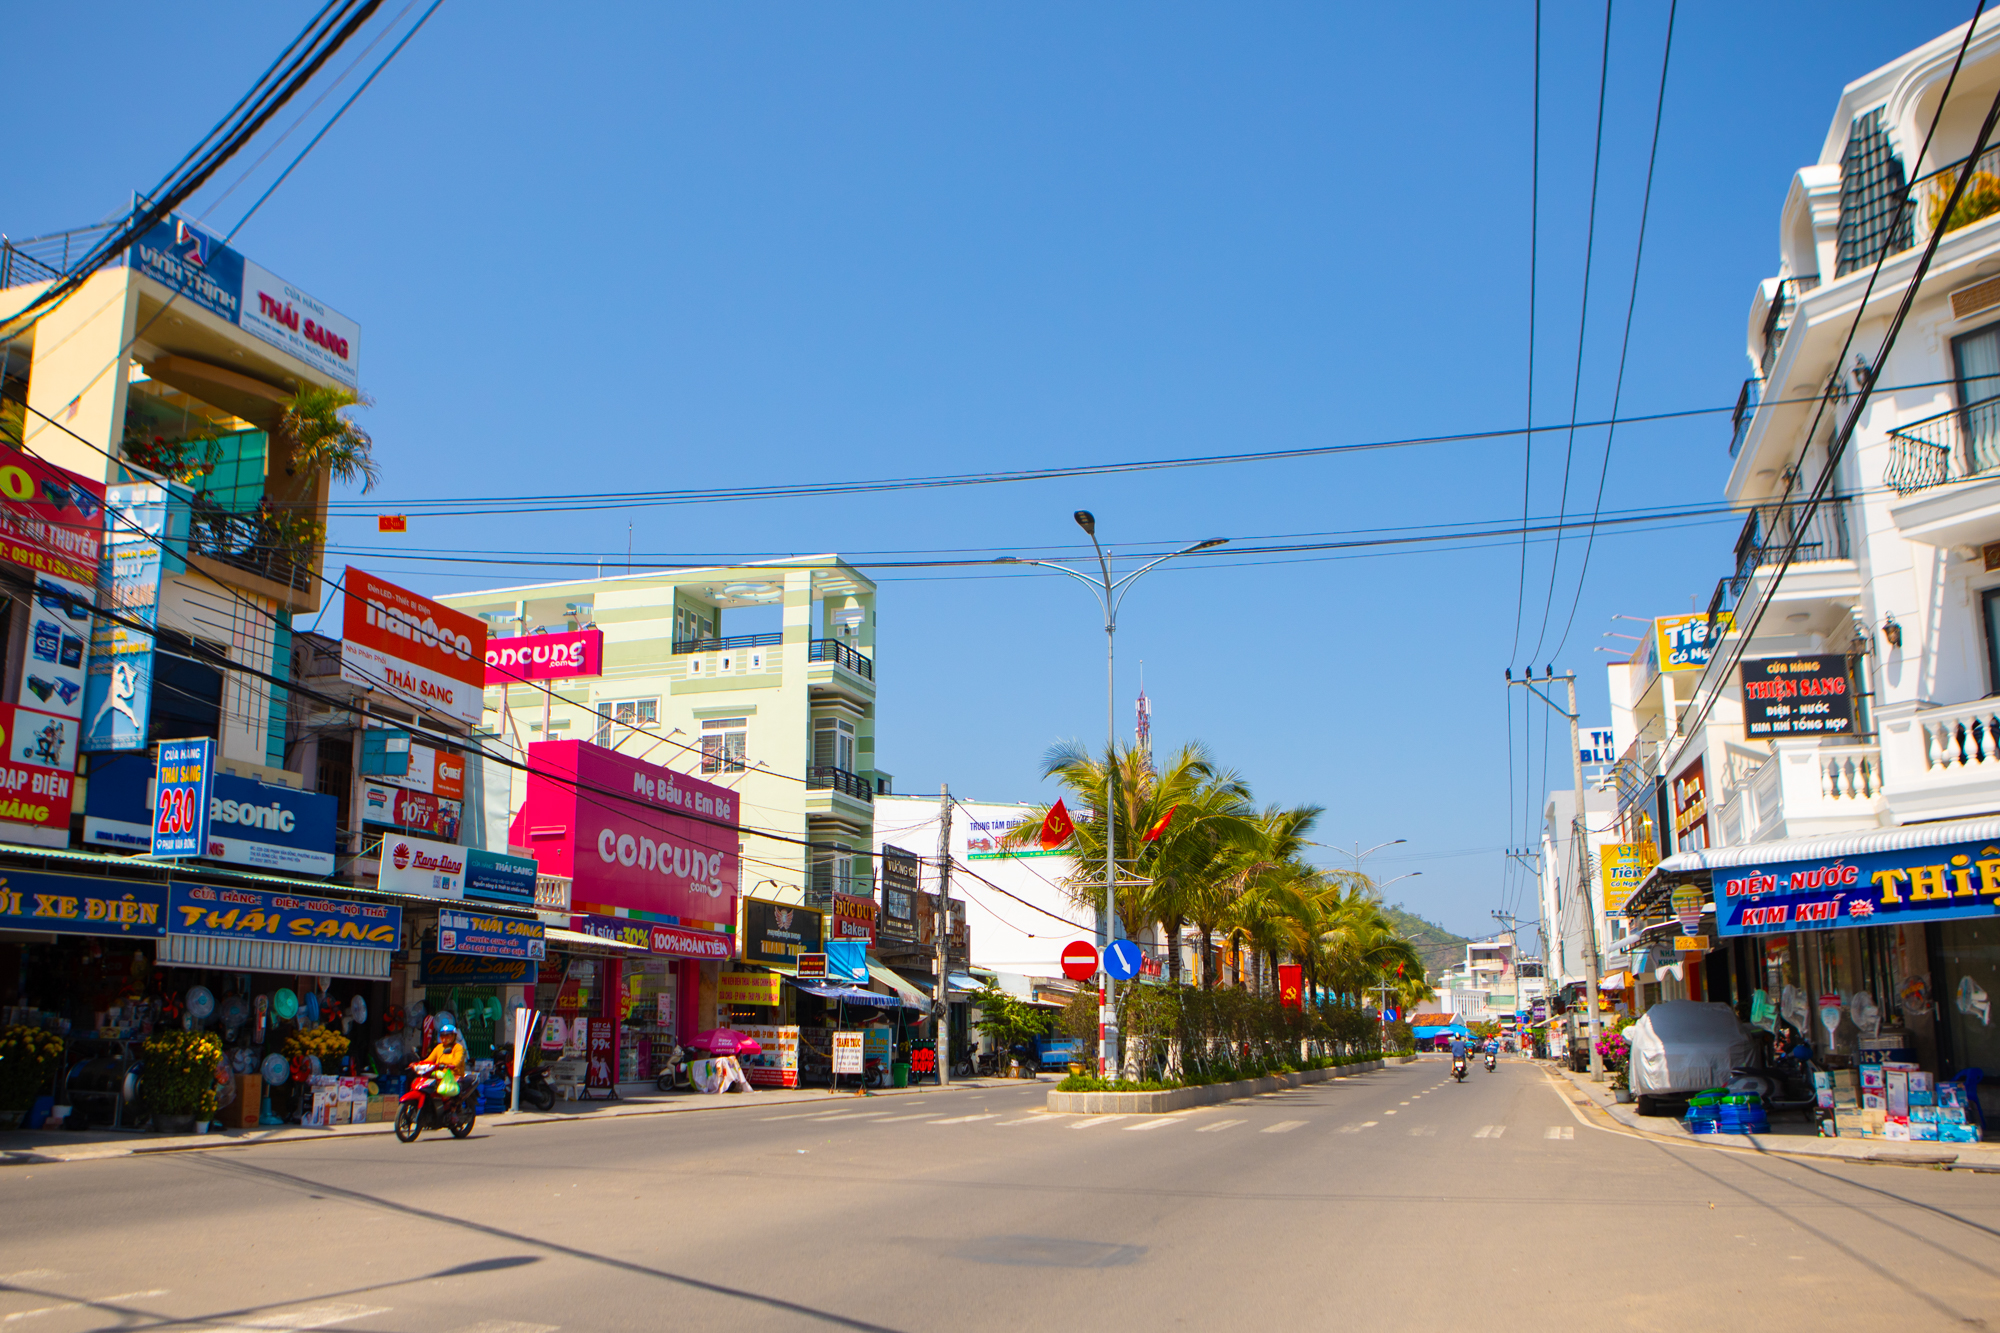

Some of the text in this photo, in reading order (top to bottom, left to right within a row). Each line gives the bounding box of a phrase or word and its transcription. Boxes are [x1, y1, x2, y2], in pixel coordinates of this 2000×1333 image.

[302, 296, 325, 318] HÀNG
[257, 289, 300, 333] THÁI
[303, 317, 349, 361] SANG
[48, 524, 99, 560] THUYỀN
[367, 582, 431, 616] Đèn LED Thiết Bị Điện
[366, 597, 472, 661] nanoco
[36, 636, 57, 651] GS
[345, 644, 387, 665] Nhà Phân Phối
[485, 639, 587, 668] oncung
[1669, 648, 1689, 665] Có
[1789, 660, 1821, 674] HÀNG
[384, 666, 416, 692] THÁI
[419, 679, 453, 705] SANG
[1746, 675, 1846, 702] THIỆN SANG
[1799, 701, 1830, 716] NƯỚC
[1750, 716, 1848, 734] KIM KHÍ TỔNG HỢP
[164, 745, 201, 761] CỬA HÀNG
[161, 763, 201, 784] THÁI SANG
[32, 771, 69, 801] ĐIỆN
[633, 772, 731, 820] Mẹ Bầu & Em Bé
[157, 787, 196, 834] 230
[209, 797, 296, 833] asonic
[401, 801, 418, 822] 10
[970, 821, 990, 831] TRUNG
[991, 819, 1005, 830] TÂM
[208, 842, 225, 857] NG
[495, 861, 512, 873] THÁI
[512, 865, 534, 877] SANG
[597, 828, 724, 898] concung .com
[1725, 859, 1858, 901] ĐIỆN NƯỚC
[32, 893, 79, 919] XE
[84, 893, 160, 931] ĐIỆN
[189, 886, 217, 901] CỬA
[272, 896, 300, 911] ĐIỆN
[305, 899, 336, 913] NƯỚC
[340, 904, 360, 917] NỘI
[362, 905, 389, 918] THẤT
[835, 897, 876, 921] ĐỨC DUY
[1741, 893, 1846, 926] KIM KHÍ
[178, 906, 395, 943] THÁI SANG
[469, 916, 503, 933] THÁI
[505, 921, 543, 938] SANG
[597, 926, 616, 942] SỮA
[842, 920, 870, 939] Bakery
[654, 933, 728, 956] 100% HOÀN TIỀN
[761, 940, 786, 955] THANH
[427, 955, 526, 979] Thái Sang
[1658, 949, 1679, 967] NHA KHOA
